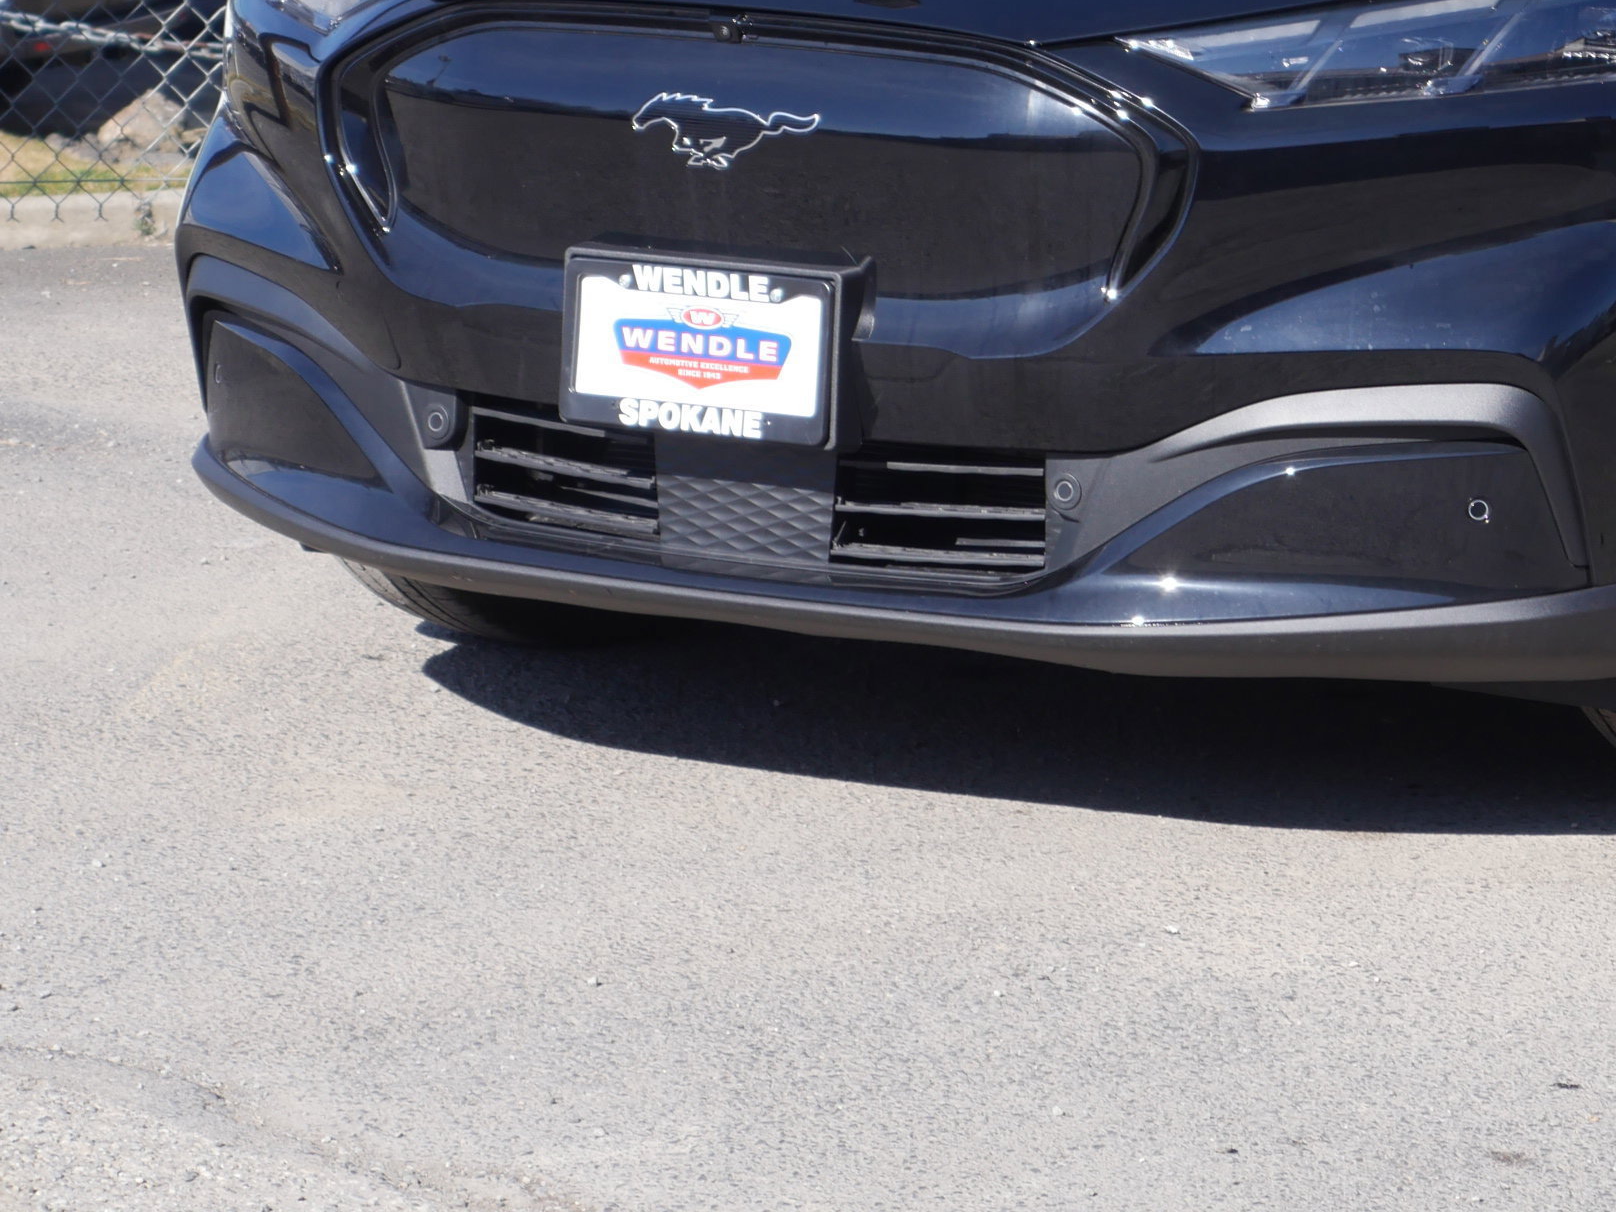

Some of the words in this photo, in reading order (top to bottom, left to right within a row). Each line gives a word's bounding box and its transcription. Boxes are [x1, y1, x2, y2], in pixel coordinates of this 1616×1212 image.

[632, 264, 770, 303] WENDLE
[621, 326, 779, 363] WENDLE
[649, 356, 699, 369] AUTOMOTIVE
[699, 360, 749, 374] EXCELLENCE
[677, 368, 702, 378] SINCE
[618, 398, 763, 439] SPOKANE
